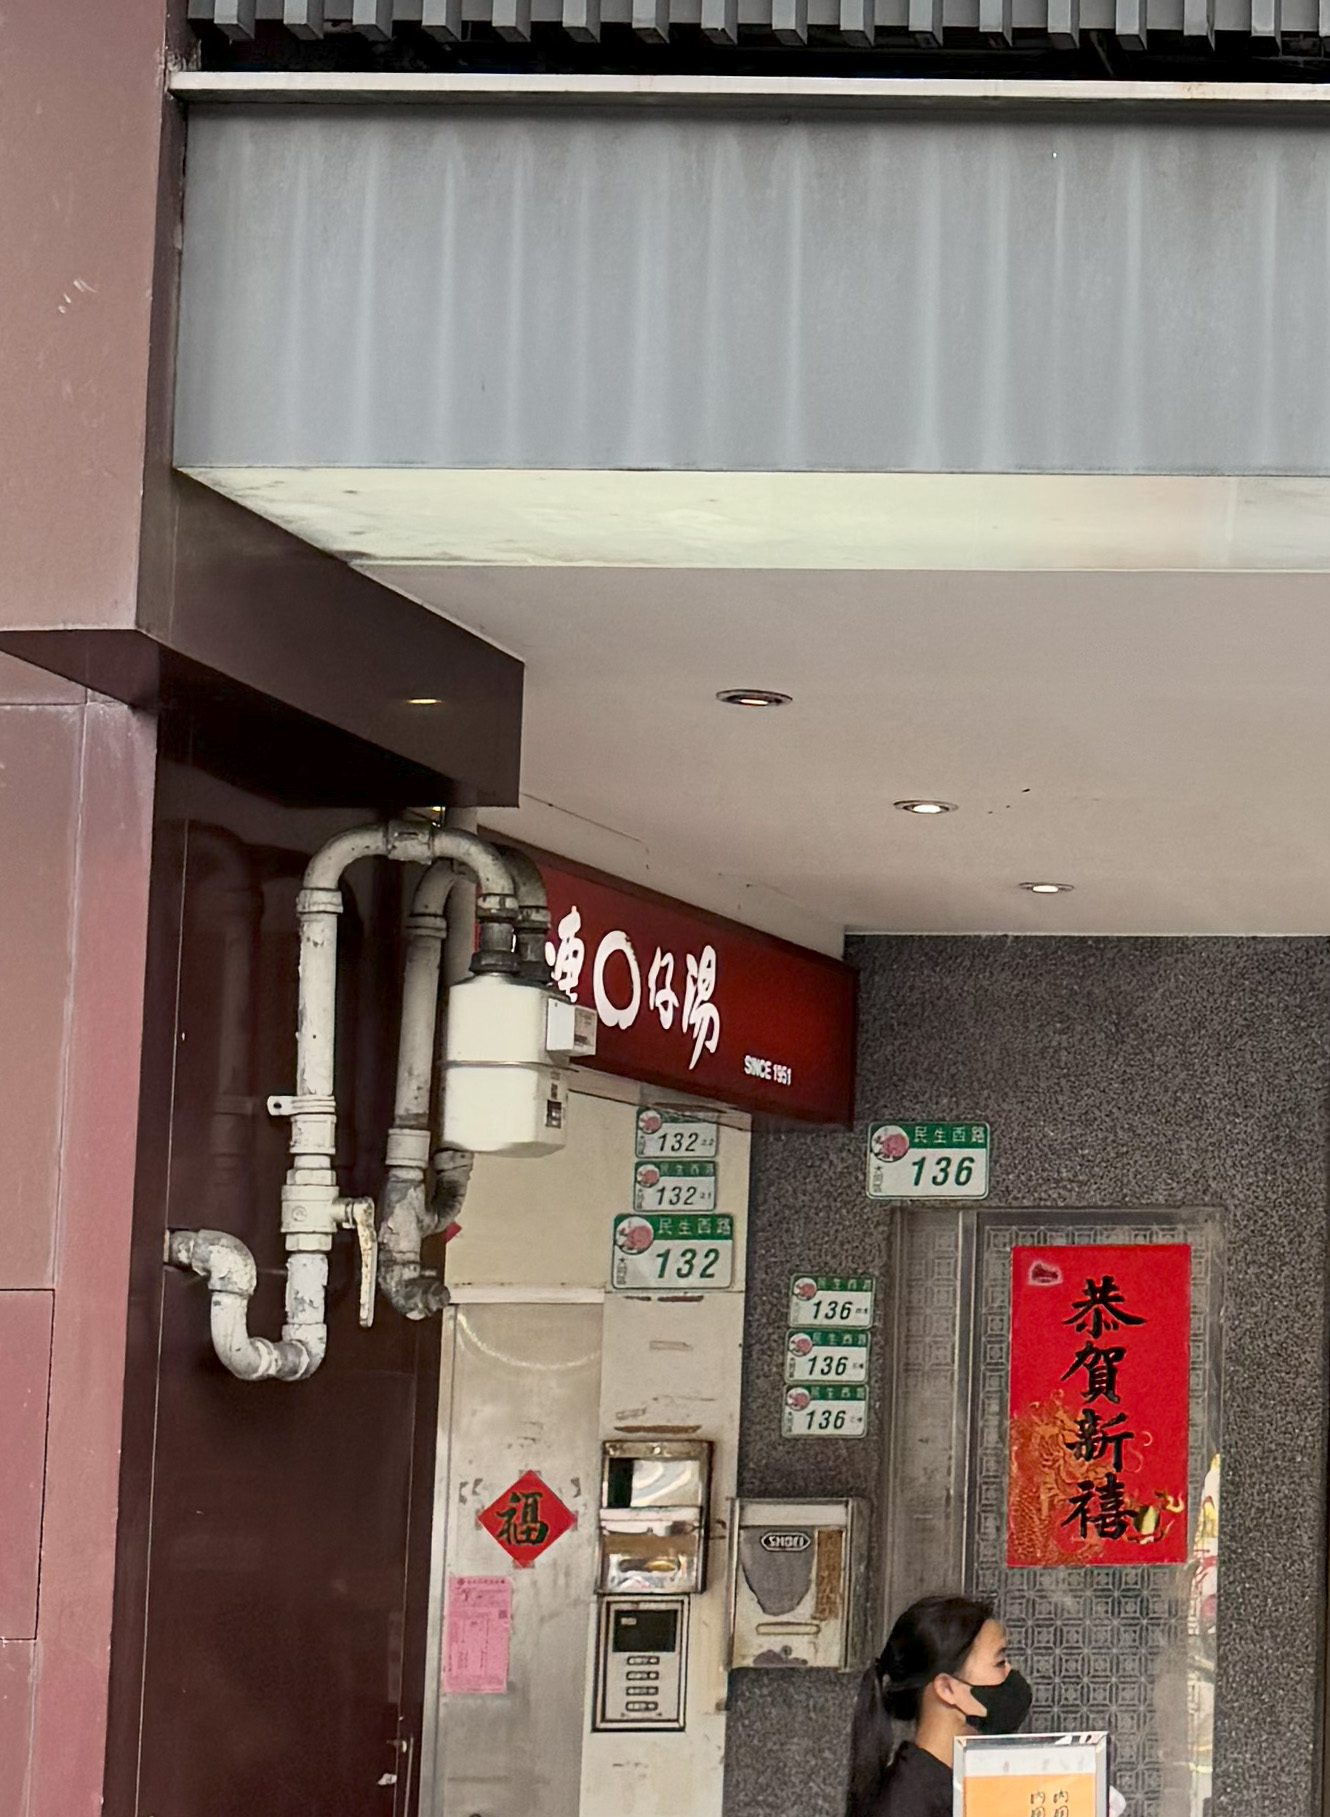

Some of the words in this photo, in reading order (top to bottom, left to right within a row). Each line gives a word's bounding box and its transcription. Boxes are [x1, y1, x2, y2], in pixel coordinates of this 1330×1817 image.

[744, 1055, 771, 1080] SINCE
[773, 1064, 791, 1086] 1951
[657, 1132, 699, 1152] 132
[914, 1126, 985, 1144] 民生西路
[912, 1156, 975, 1187] 136
[656, 1186, 697, 1206] 132
[658, 1218, 732, 1235] 民生西路
[655, 1248, 720, 1279] 132
[812, 1300, 852, 1320] 136
[807, 1356, 848, 1376] 136
[1060, 1275, 1148, 1540] 恭賀新禧
[806, 1410, 846, 1430] 136
[495, 1491, 550, 1546] 福
